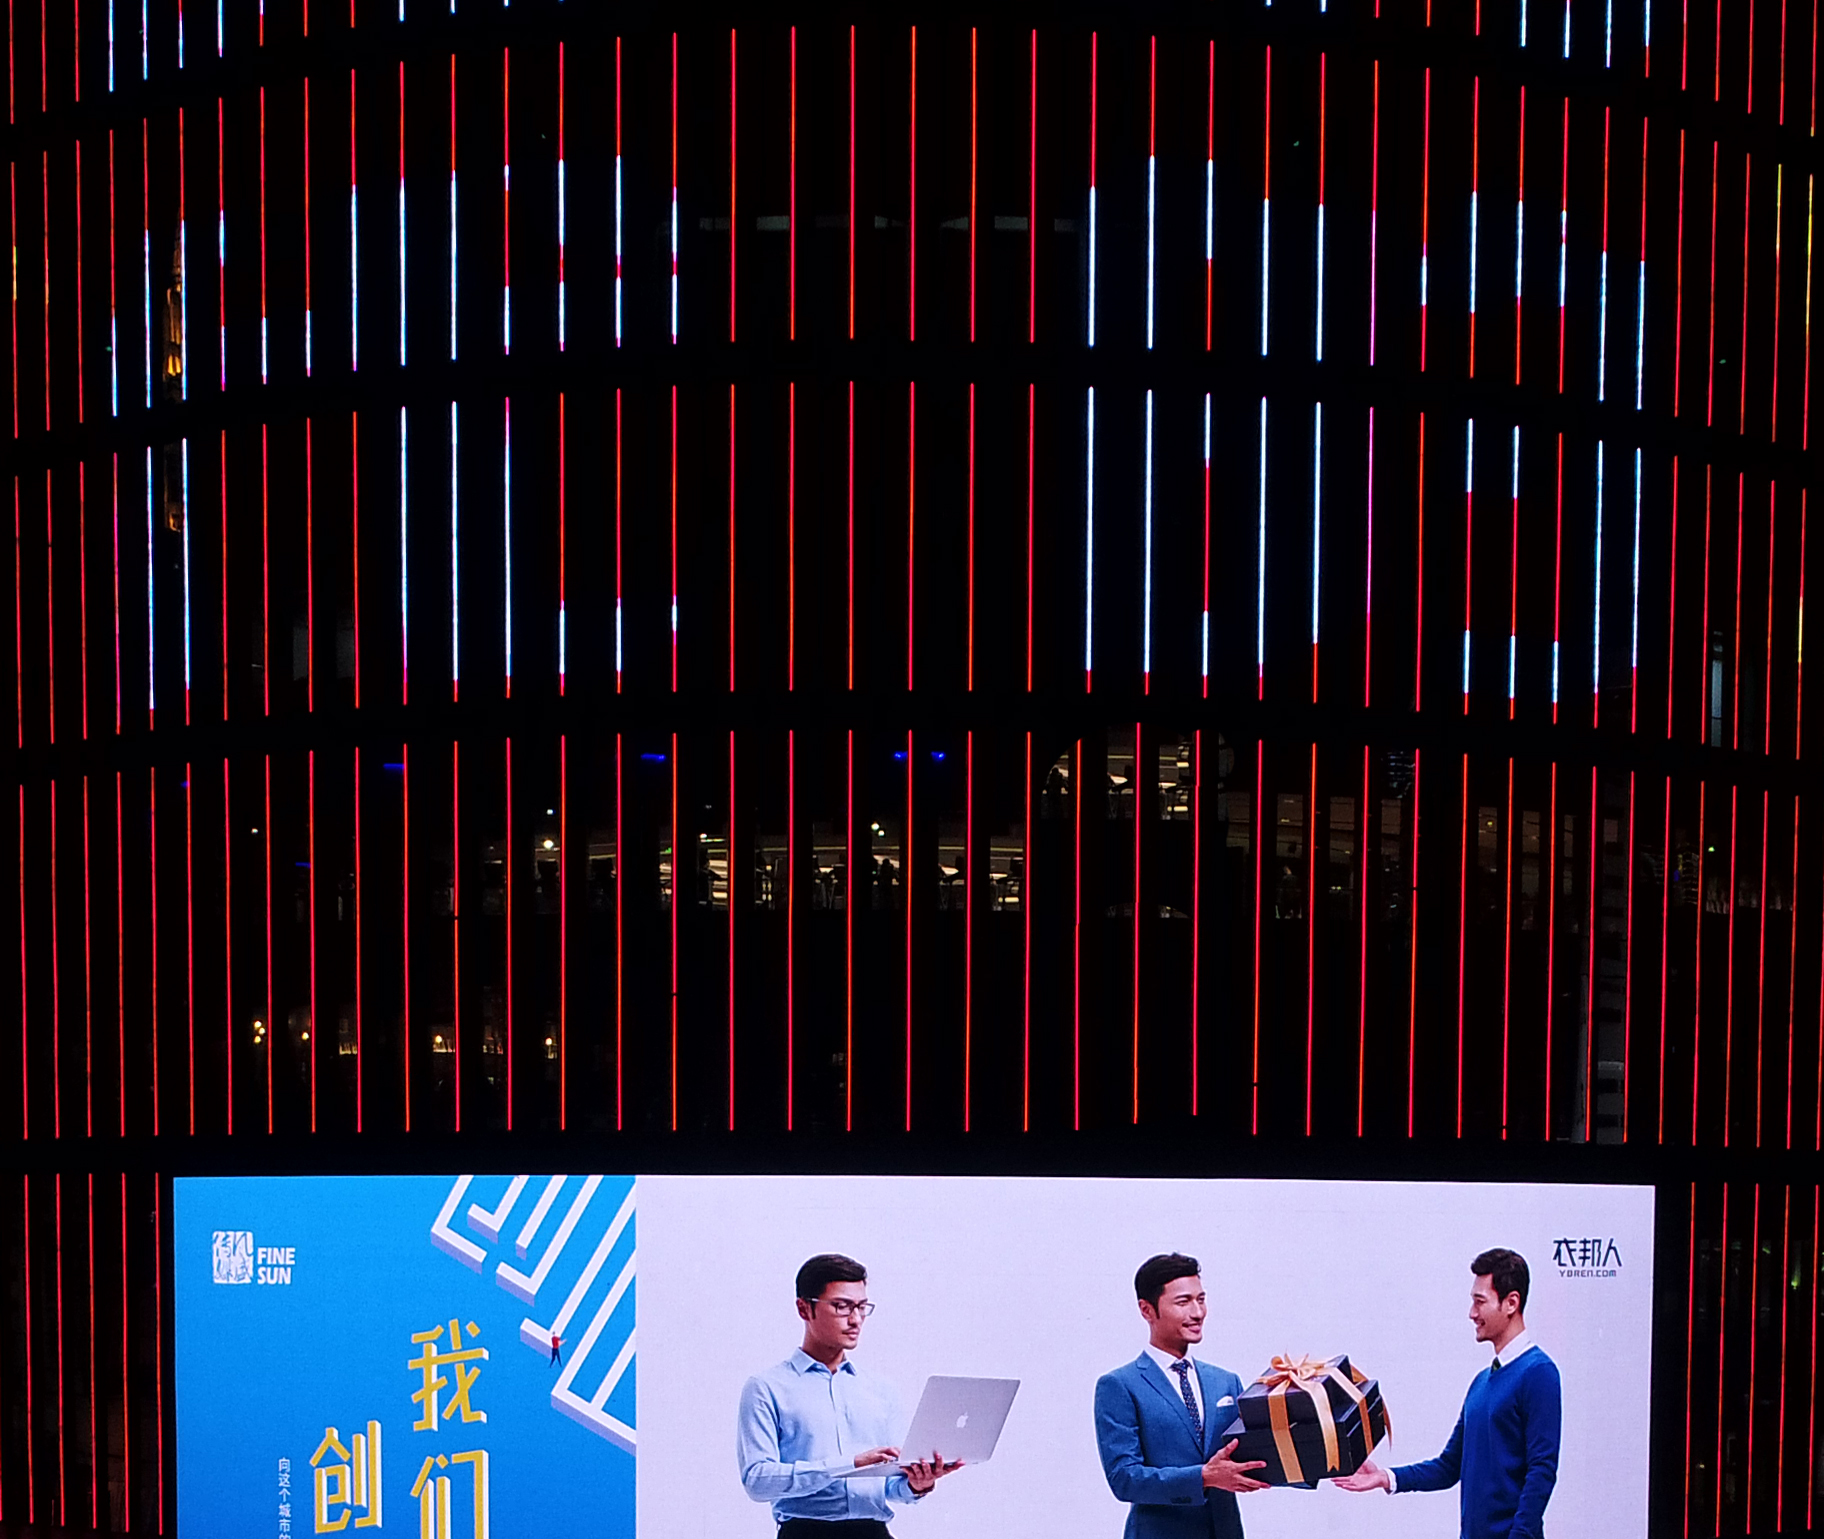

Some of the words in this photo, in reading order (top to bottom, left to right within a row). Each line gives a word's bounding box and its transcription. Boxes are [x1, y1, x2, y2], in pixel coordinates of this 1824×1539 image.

[257, 1247, 296, 1265] FINE
[1552, 1238, 1622, 1267] 衣邦人
[257, 1266, 292, 1285] SUN
